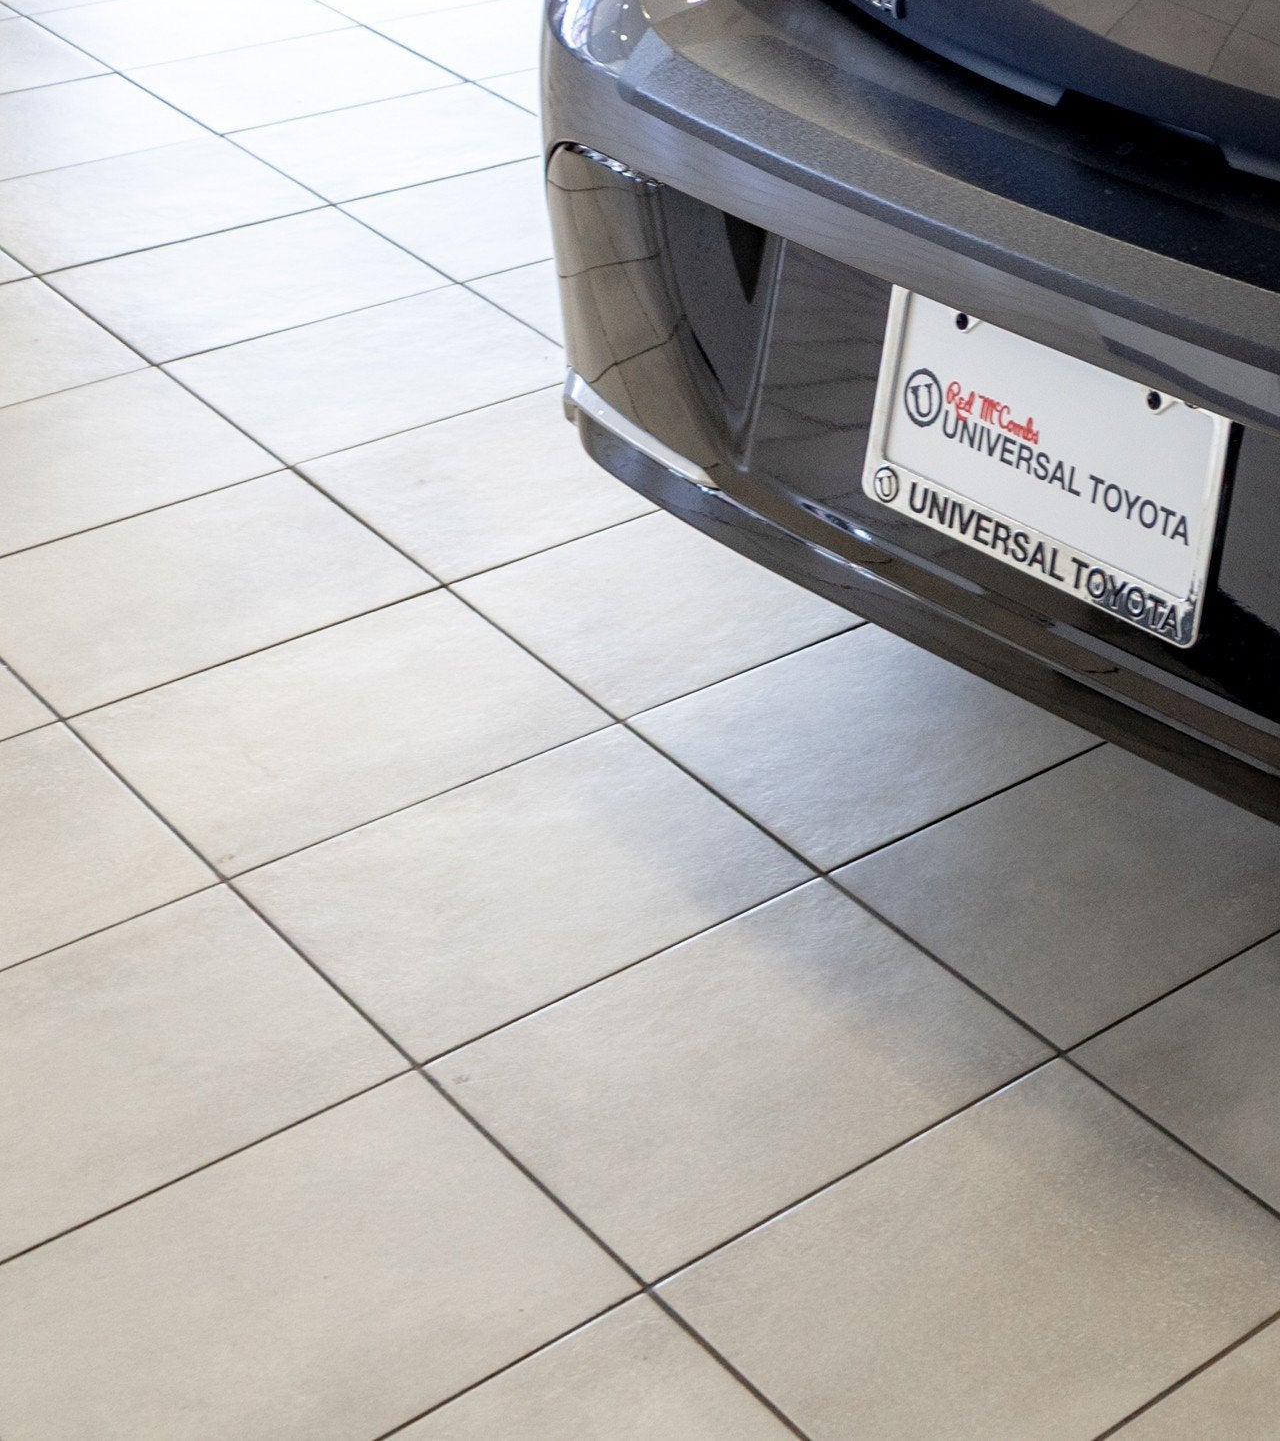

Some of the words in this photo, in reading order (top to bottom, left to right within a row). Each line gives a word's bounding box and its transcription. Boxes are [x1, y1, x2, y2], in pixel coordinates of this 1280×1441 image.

[942, 409, 1081, 497] UNIVERSAL
[1088, 473, 1190, 546] TOYOTA
[945, 380, 976, 423] Red
[977, 392, 1039, 445] McCombs
[908, 481, 1066, 582] UNIVERSAL
[1070, 557, 1183, 639] TOYOTA
